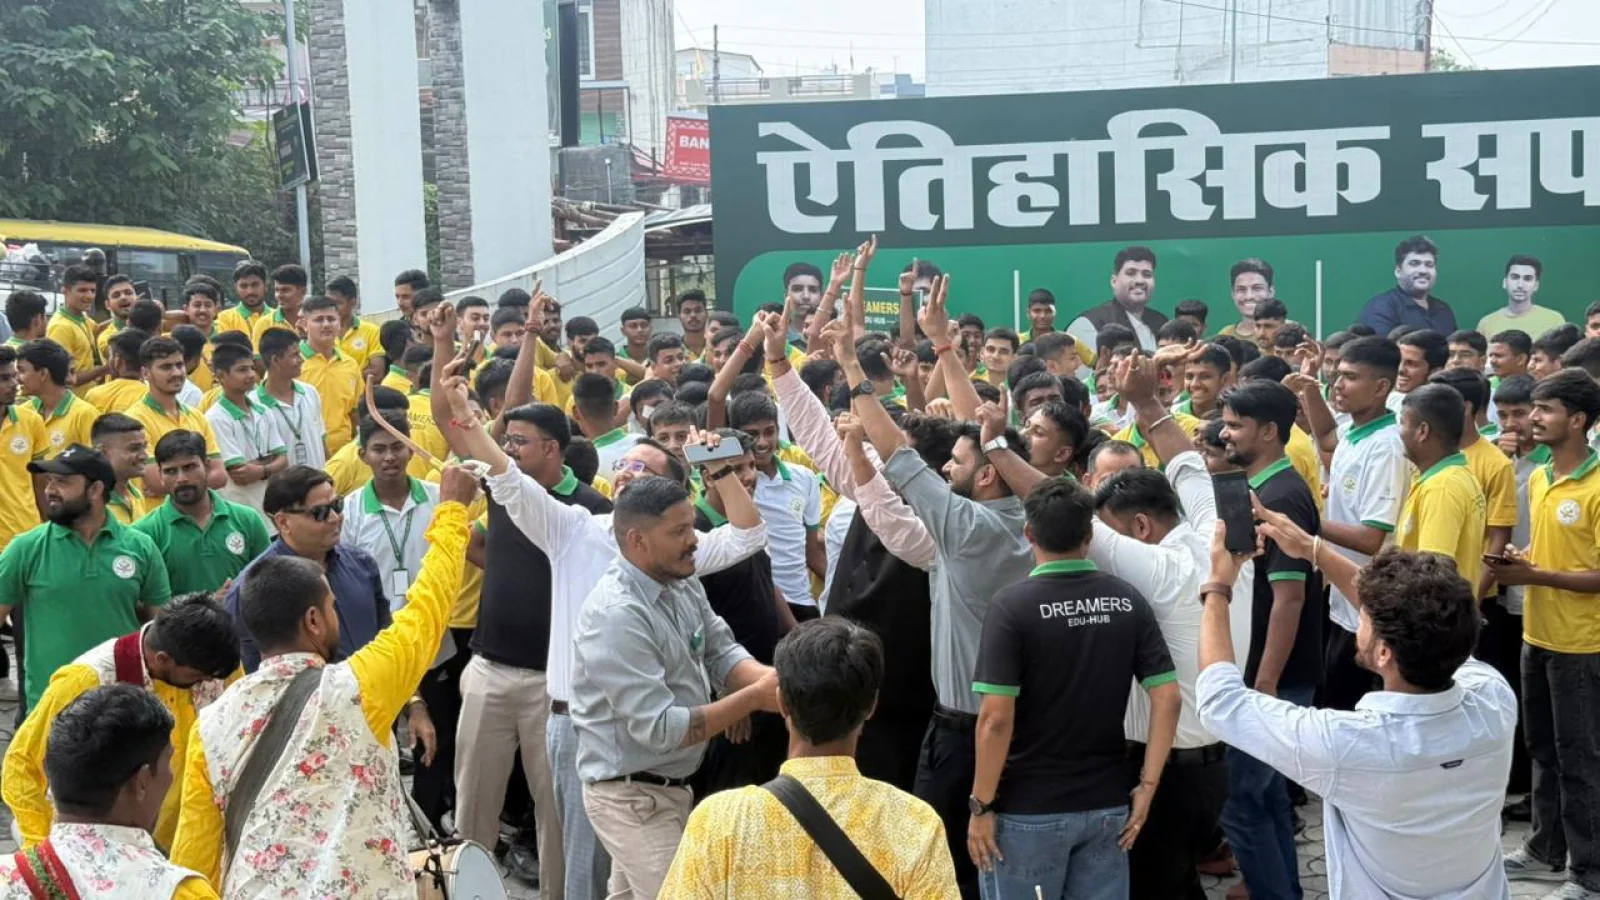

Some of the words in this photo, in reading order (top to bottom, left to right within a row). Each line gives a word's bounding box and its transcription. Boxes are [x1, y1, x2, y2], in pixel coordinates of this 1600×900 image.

[680, 135, 709, 149] BAN
[757, 109, 1391, 233] ऐतिहासिक
[1040, 597, 1133, 619] DREAMERS
[1068, 615, 1110, 627] EDU-HUB
